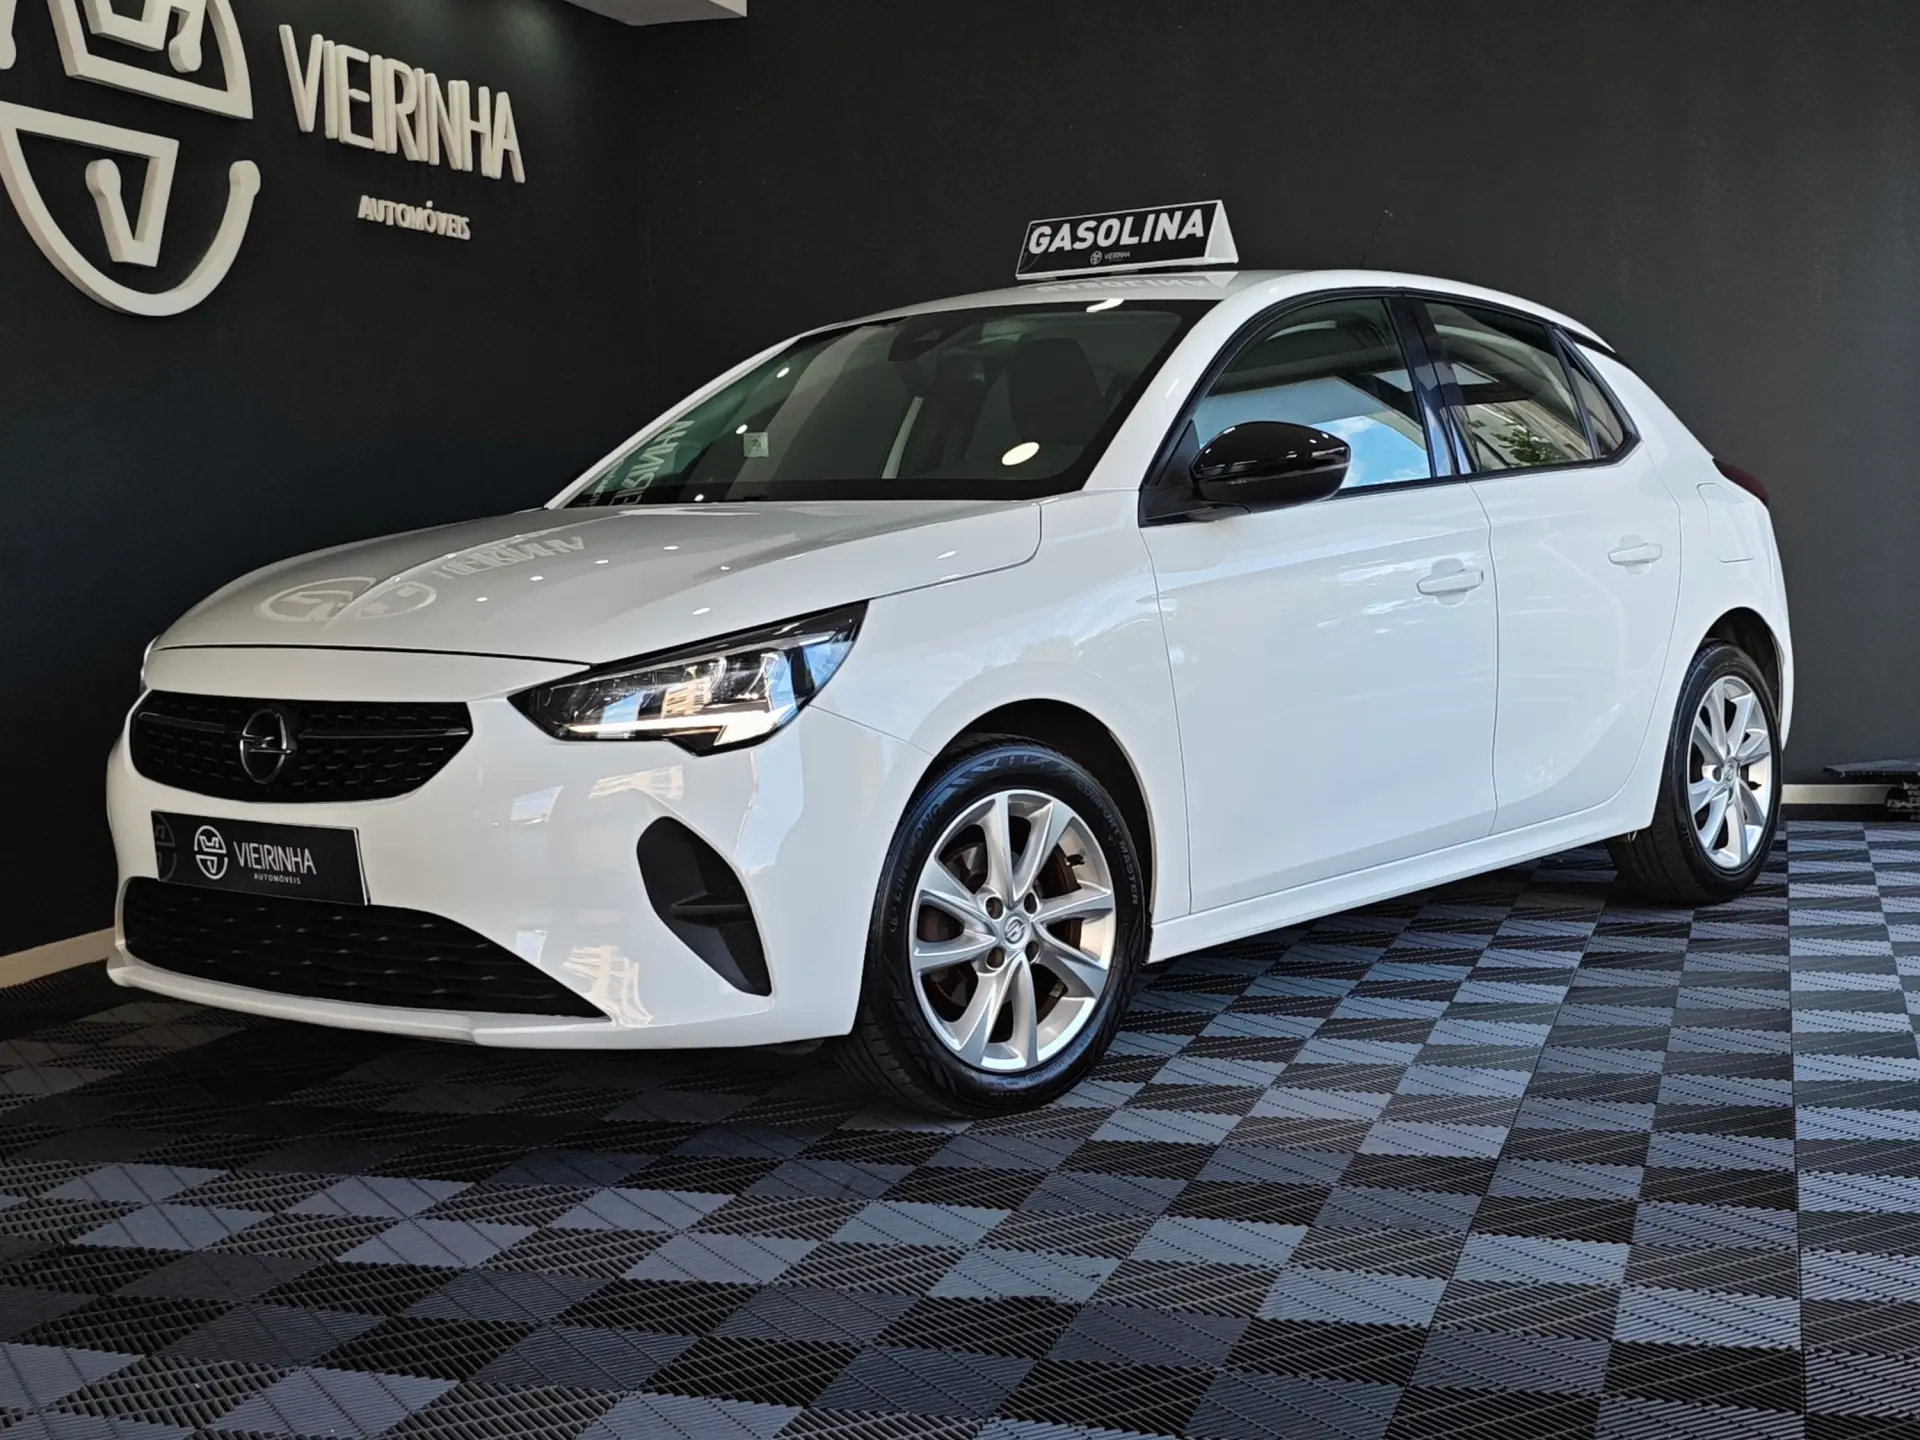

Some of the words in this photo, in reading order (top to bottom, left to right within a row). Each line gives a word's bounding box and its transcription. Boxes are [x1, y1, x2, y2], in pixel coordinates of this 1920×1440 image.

[278, 24, 526, 183] VIEIRINHA
[357, 194, 471, 240] AUTOMÓVEIS
[1028, 208, 1204, 255] GASOLINA
[233, 840, 317, 875] VIEIRINHA
